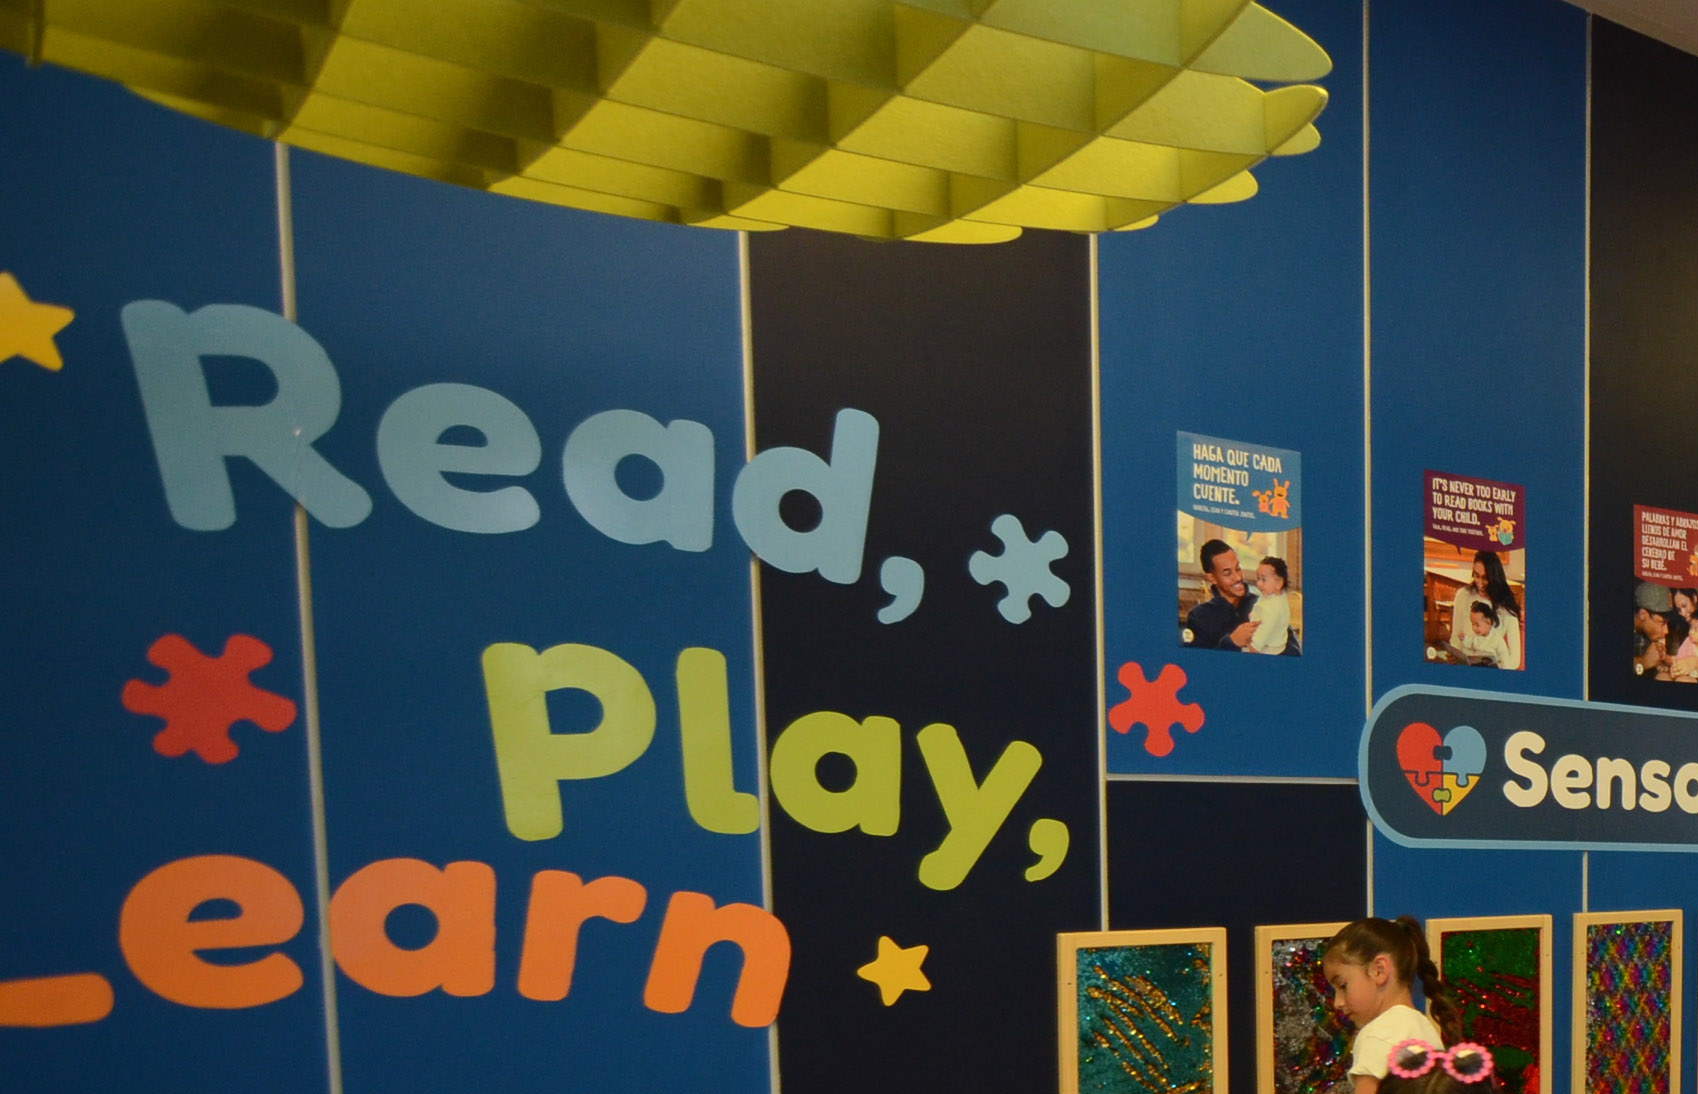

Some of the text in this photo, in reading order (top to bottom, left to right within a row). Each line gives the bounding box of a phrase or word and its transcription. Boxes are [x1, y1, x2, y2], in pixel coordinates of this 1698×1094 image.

[121, 299, 925, 625] Read,
[1192, 443, 1283, 474] HAGA QUE CADA
[1192, 462, 1249, 487] MOMENTO
[1192, 483, 1241, 505] CUENTE.
[1431, 477, 1517, 503] IT'S NEVER TOO EARLY
[1431, 491, 1514, 516] TO READ BOOKS WITH
[1431, 506, 1481, 526] YOUR CHILD.
[1641, 511, 1671, 526] PALABRAS
[1670, 516, 1676, 526] Y
[1641, 523, 1688, 540] LLENOS DE AMOR
[1641, 546, 1676, 561] CEREBRO DE
[1680, 540, 1689, 551] EL
[1641, 558, 1650, 569] SU
[481, 641, 1070, 891] Play,
[0, 855, 793, 1028] earn
